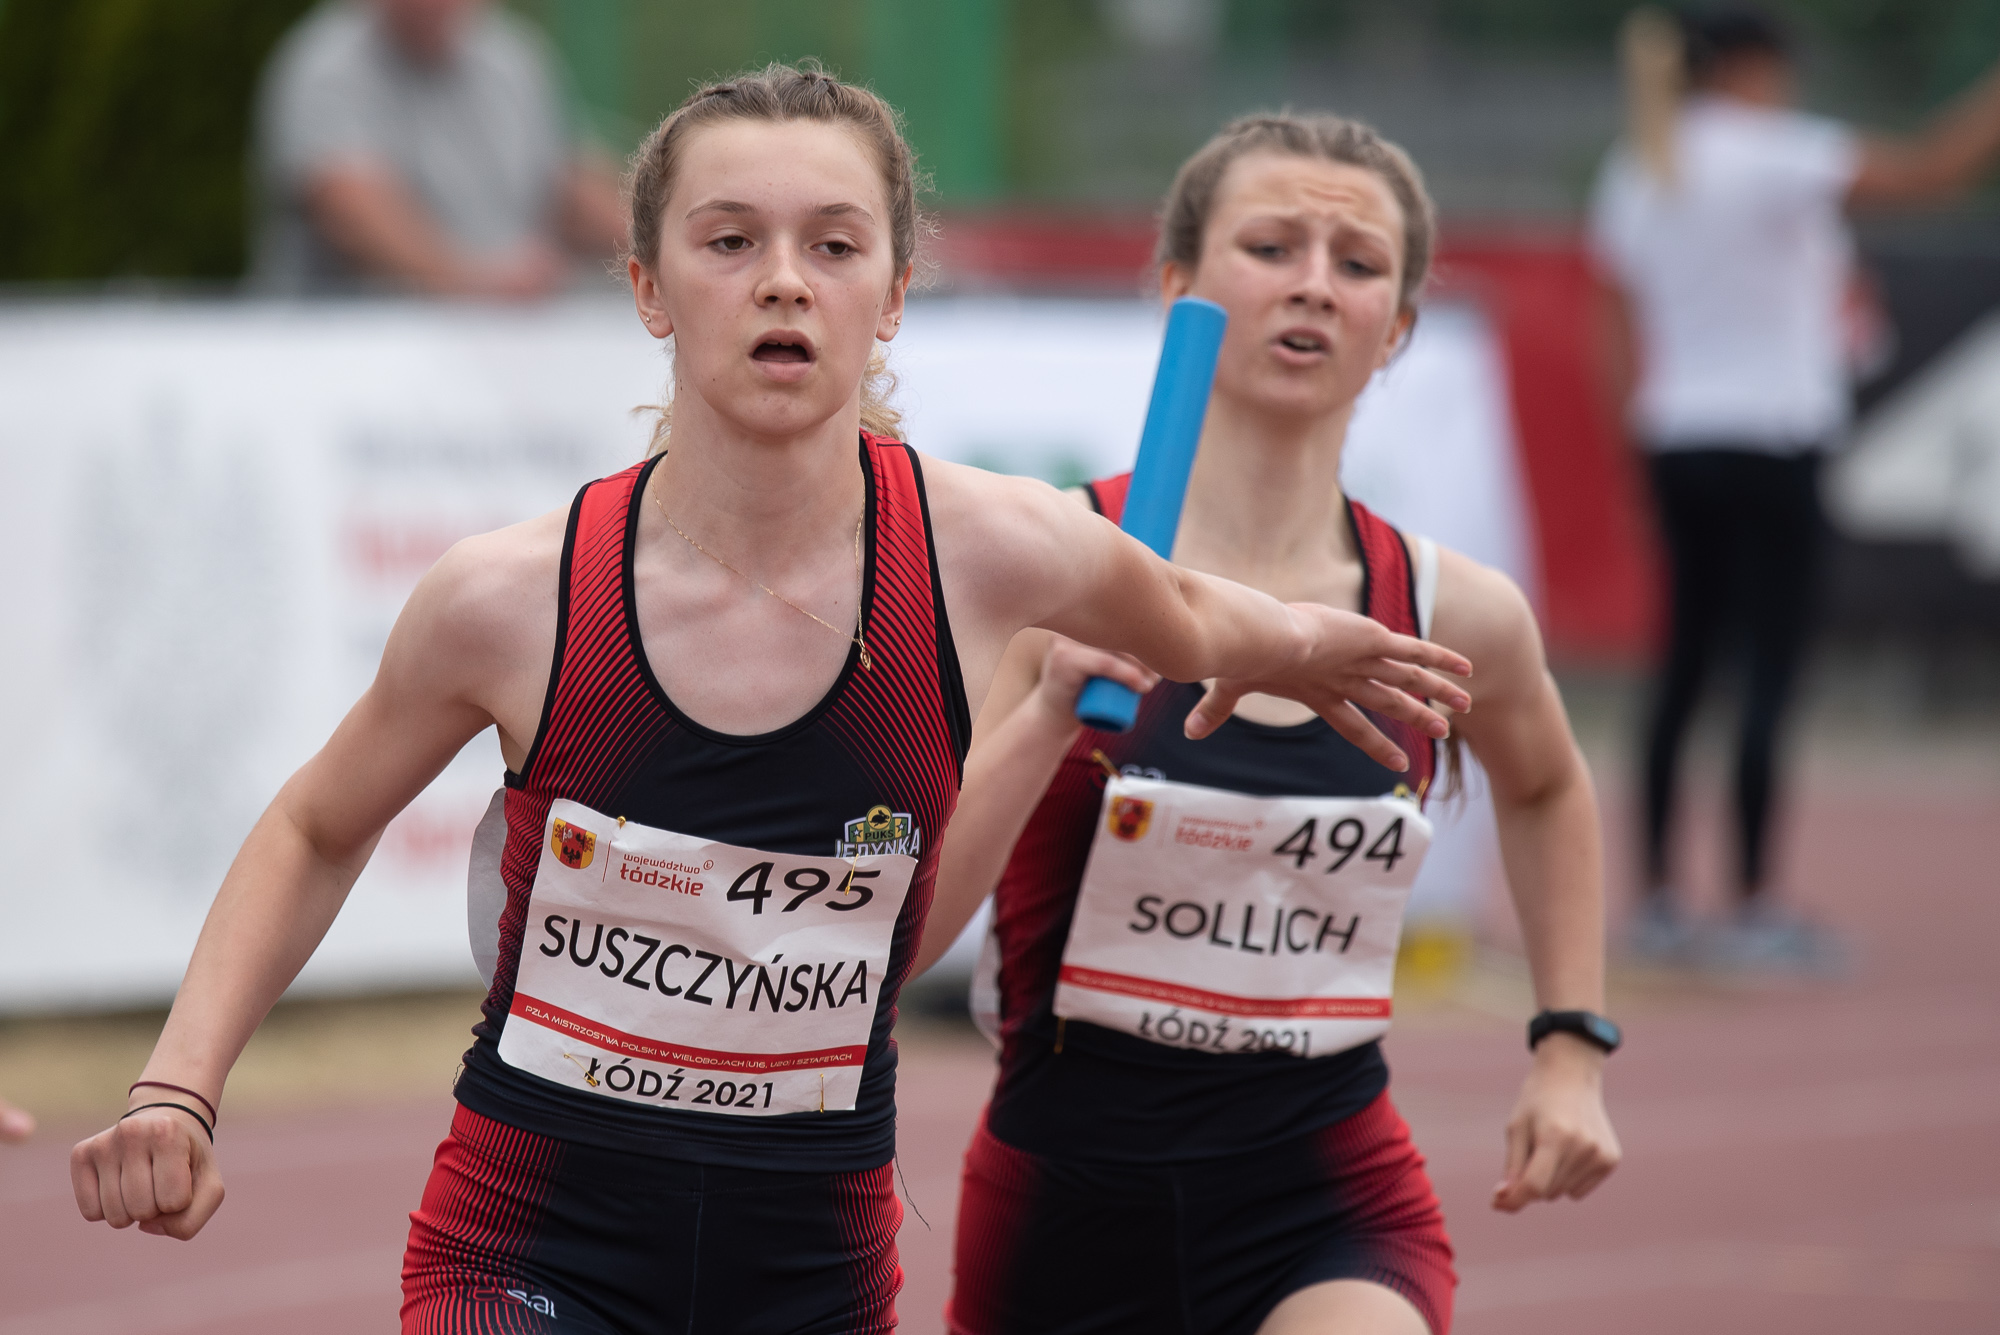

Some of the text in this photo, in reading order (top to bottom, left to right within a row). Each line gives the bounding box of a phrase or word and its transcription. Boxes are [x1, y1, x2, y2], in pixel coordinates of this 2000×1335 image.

[864, 829, 895, 841] PUKS
[1273, 817, 1405, 874] 494
[620, 862, 704, 896] łódzkie
[623, 853, 700, 875] województwo
[726, 861, 881, 915] 495
[1128, 895, 1361, 956] SOLLICH
[538, 914, 868, 1013] SUSZCZYŃSKA
[525, 1004, 550, 1021] PZLA
[551, 1015, 619, 1047] MISTRZOSTWA
[621, 1041, 658, 1056] POLSKI
[660, 1049, 670, 1058] W
[672, 1051, 745, 1068] WIELOBOJACH
[796, 1053, 853, 1066] SZTAFETACH
[1139, 1007, 1230, 1050] ŁÓDŹ
[584, 1057, 774, 1109] ŁÓDŹ 2021
